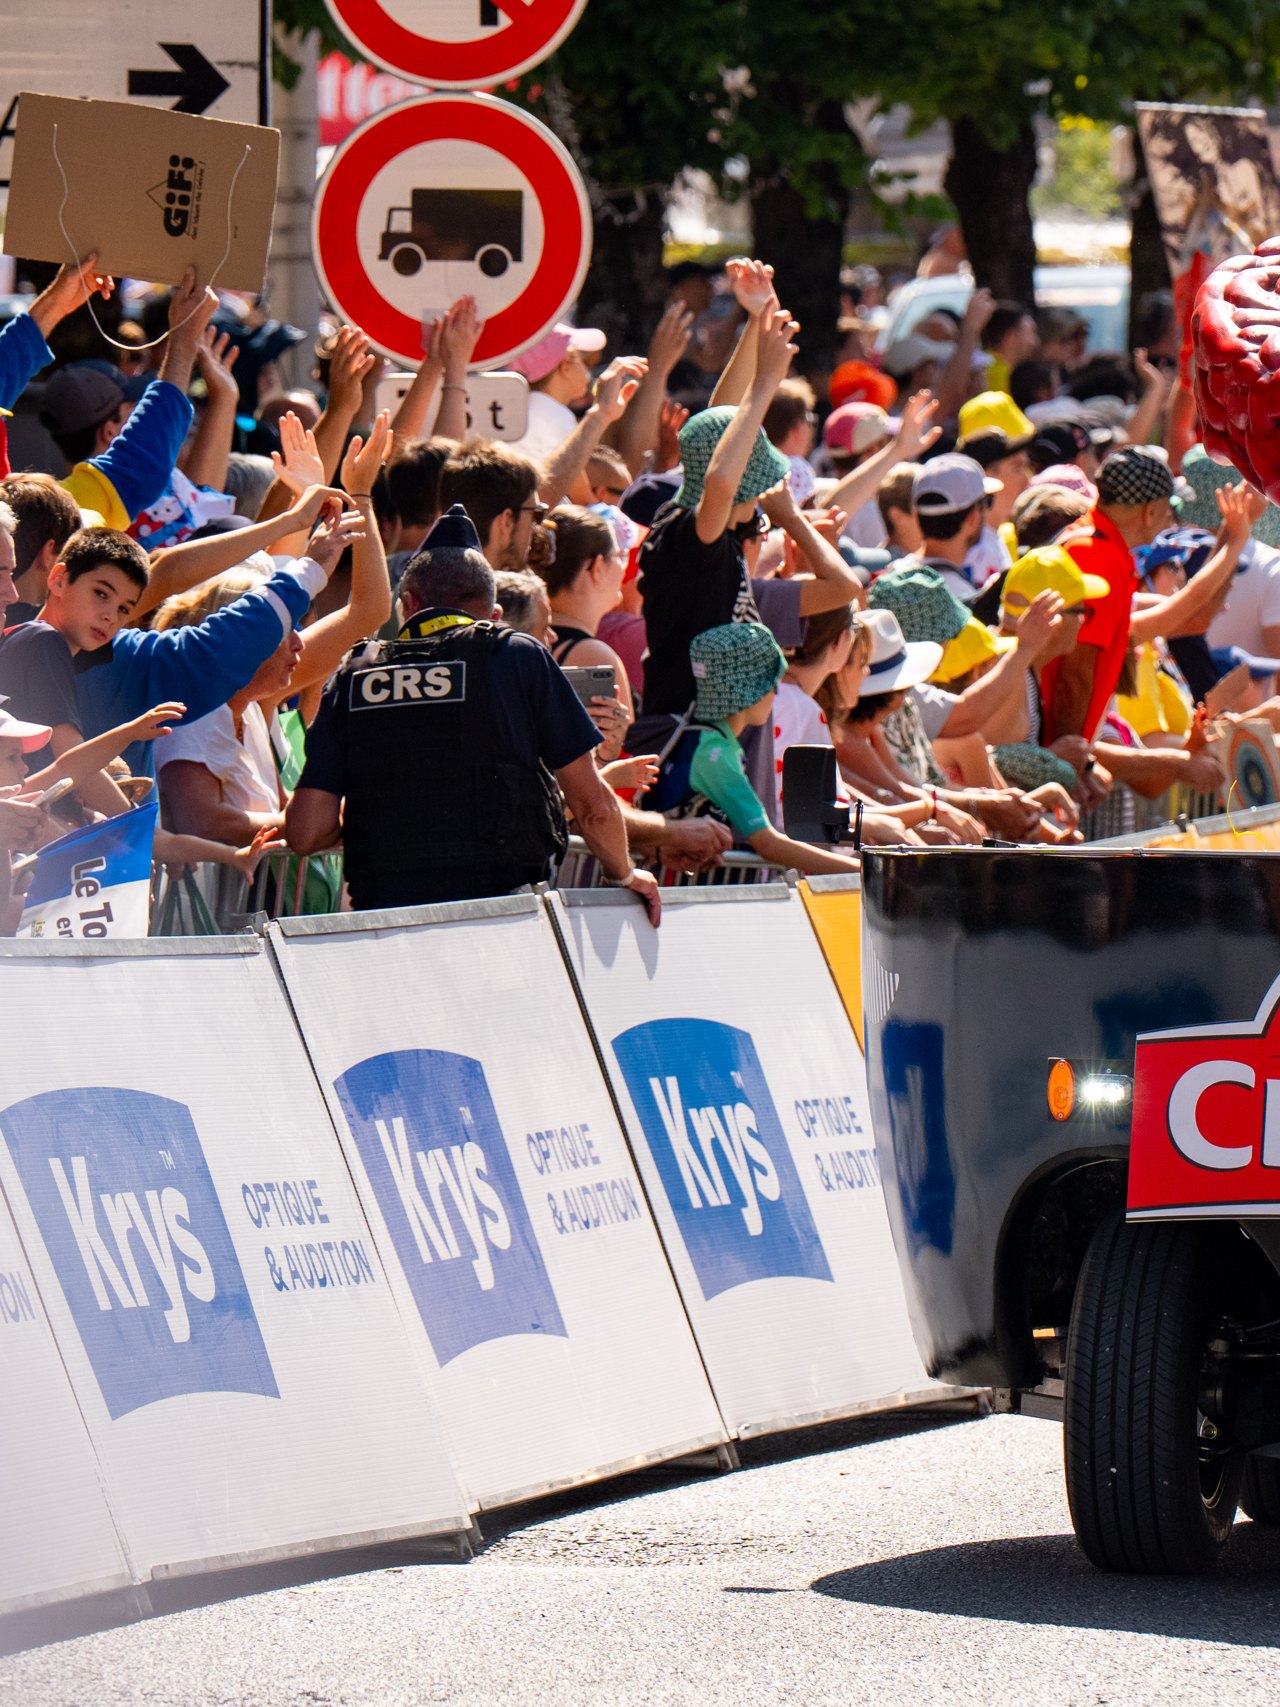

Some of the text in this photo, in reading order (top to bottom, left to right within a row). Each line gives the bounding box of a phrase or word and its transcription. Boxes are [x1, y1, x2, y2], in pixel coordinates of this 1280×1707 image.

[489, 401, 504, 431] t
[361, 666, 452, 703] CRS
[72, 857, 106, 898] Le
[794, 1096, 863, 1138] OPTIQUE
[526, 1123, 601, 1176] OPTIQUE
[649, 1075, 781, 1237] Krys
[814, 1148, 881, 1192] & AUDITI
[241, 1179, 331, 1229] OPTIQUE
[375, 1116, 511, 1291] Krys
[547, 1177, 643, 1235] & AUDITION
[48, 1156, 216, 1344] Krys
[264, 1239, 376, 1292] & AUDITION
